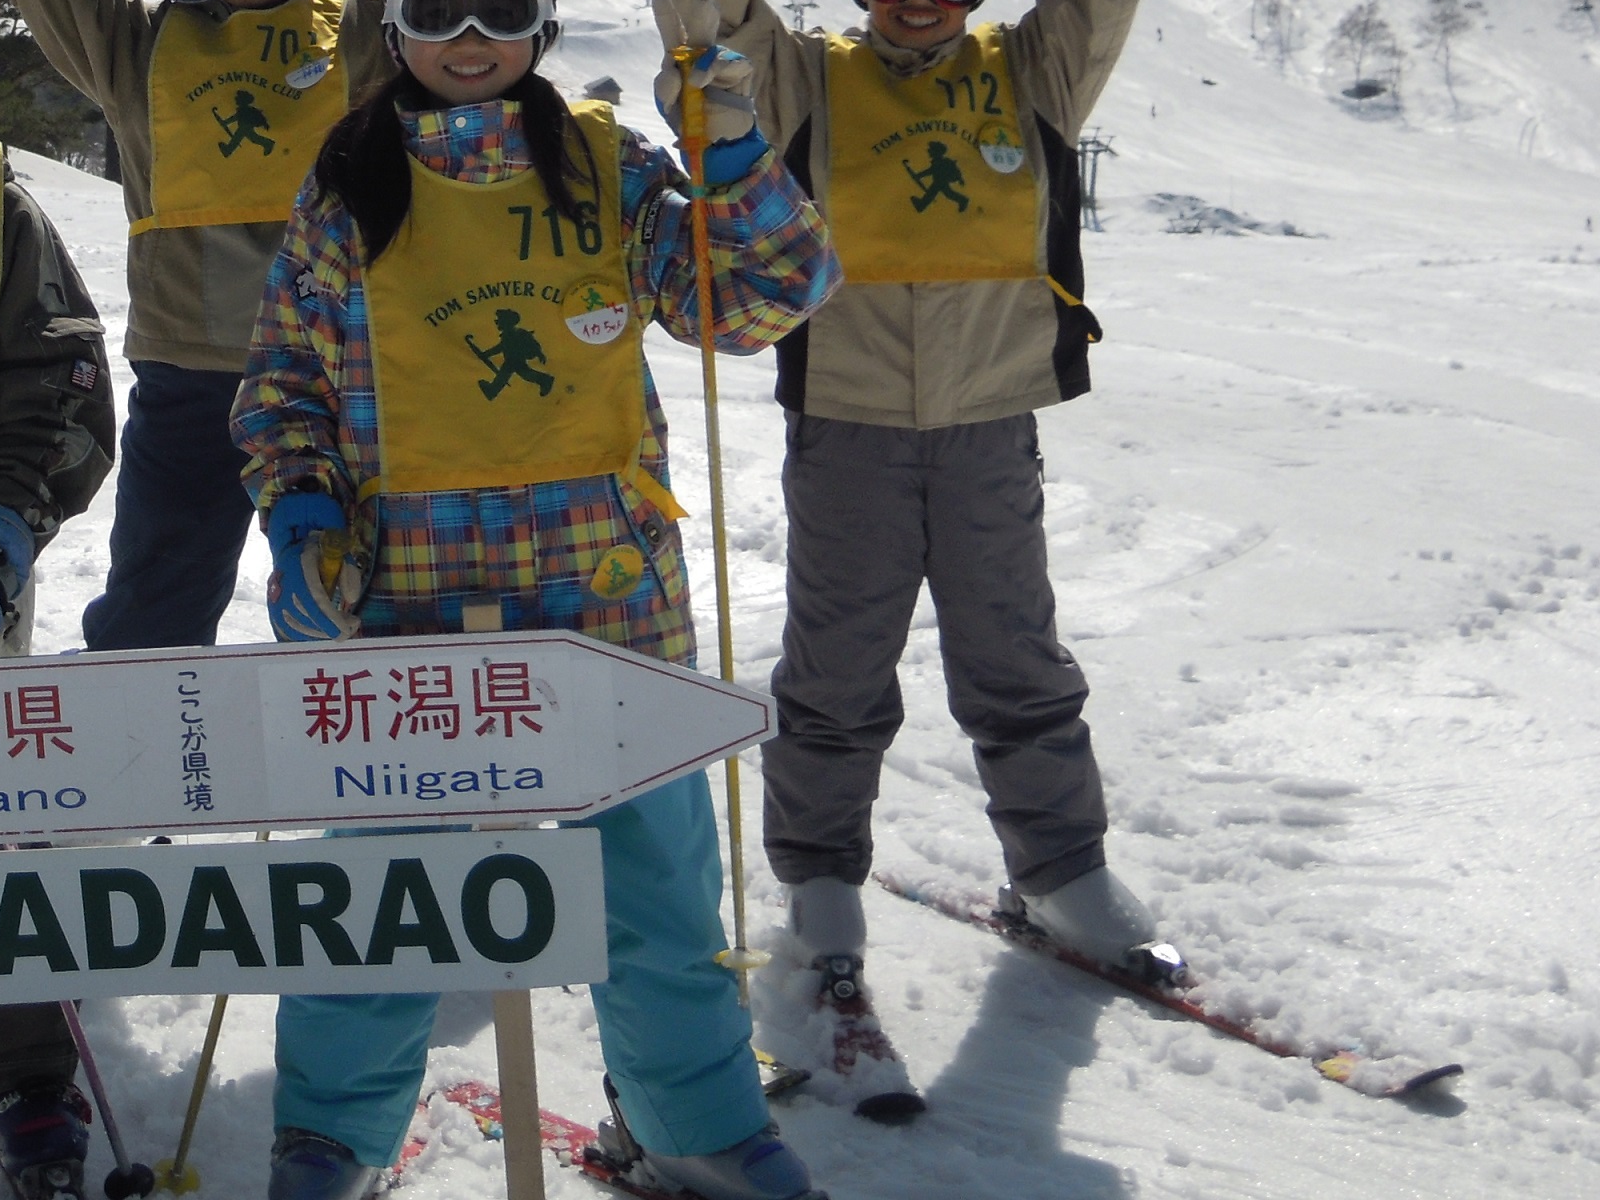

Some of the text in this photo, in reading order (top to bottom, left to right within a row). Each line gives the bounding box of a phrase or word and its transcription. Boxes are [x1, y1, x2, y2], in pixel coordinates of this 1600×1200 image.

[186, 71, 302, 102] TOM SAWYER CLUB
[935, 72, 1002, 114] 712
[872, 132, 902, 154] TOM
[905, 121, 957, 136] SAWYER
[508, 201, 602, 261] 716
[425, 298, 463, 327] TOM
[466, 280, 534, 305] SAWYER
[542, 285, 564, 306] CL
[302, 662, 543, 744] 新潟県
[178, 671, 215, 812] ここが県境
[334, 763, 544, 800] Niigata
